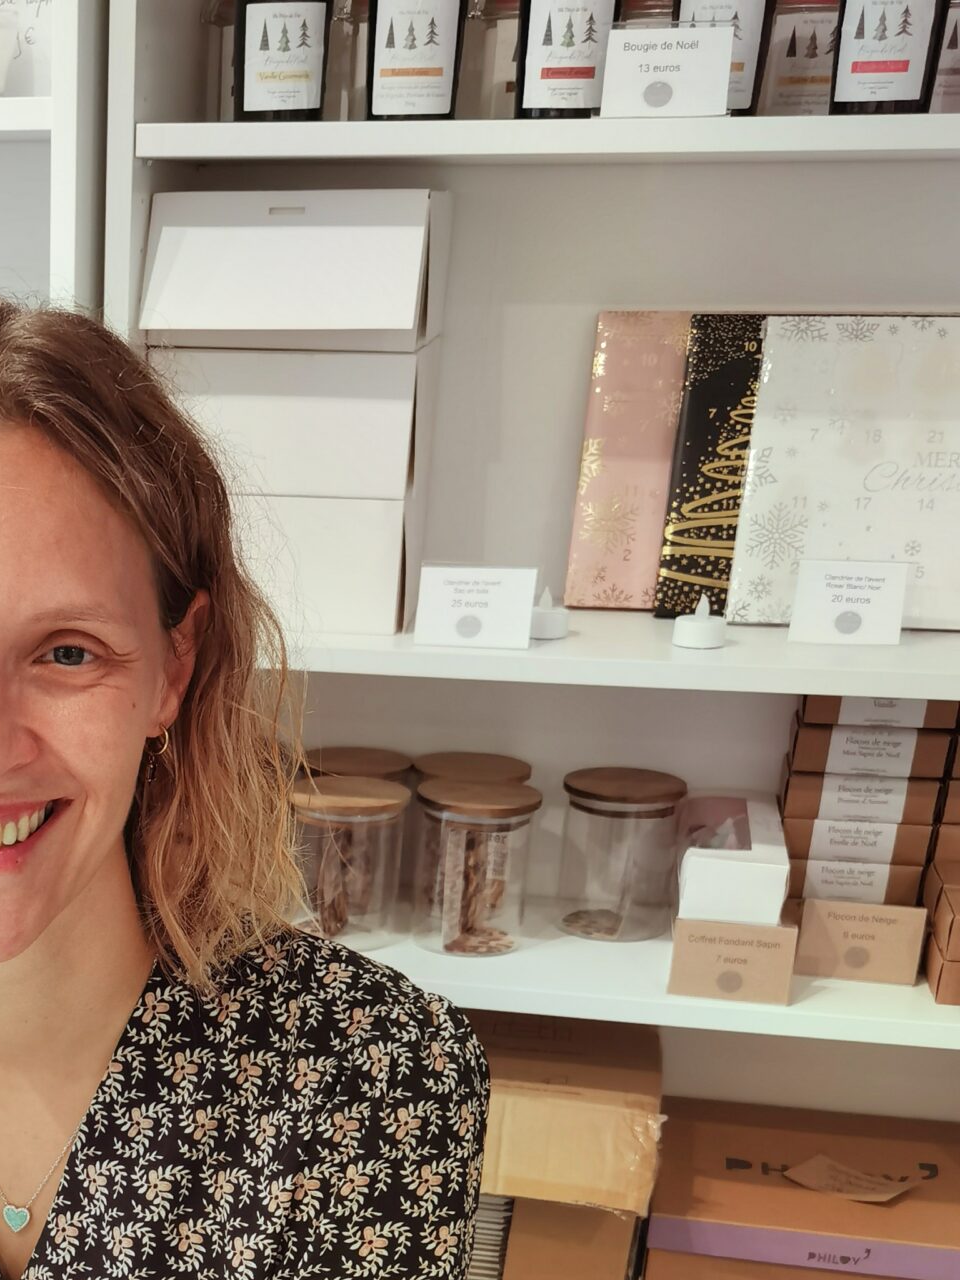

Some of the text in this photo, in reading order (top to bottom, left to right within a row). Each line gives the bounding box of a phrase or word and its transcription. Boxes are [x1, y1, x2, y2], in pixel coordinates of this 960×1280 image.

[623, 40, 699, 53] Bougie de Noël
[638, 64, 680, 73] 13 euros
[744, 341, 758, 352] 10
[708, 407, 718, 418] 7
[810, 428, 820, 441] 7
[866, 429, 883, 443] 18
[927, 430, 945, 444] 21
[912, 451, 960, 469] MER
[722, 499, 734, 509] 11
[854, 497, 873, 510] 17
[918, 498, 936, 511] 14
[622, 549, 632, 562] 2
[717, 558, 727, 569] 2
[915, 566, 925, 579] 5
[451, 599, 489, 609] 25 euros
[832, 594, 871, 604] 20 euros
[838, 784, 894, 796] Flocon de neige
[827, 911, 898, 926] Flocon de Neige
[688, 934, 781, 951] Coffret Fondant Sapin
[851, 933, 876, 942] euros
[723, 957, 748, 966] euros
